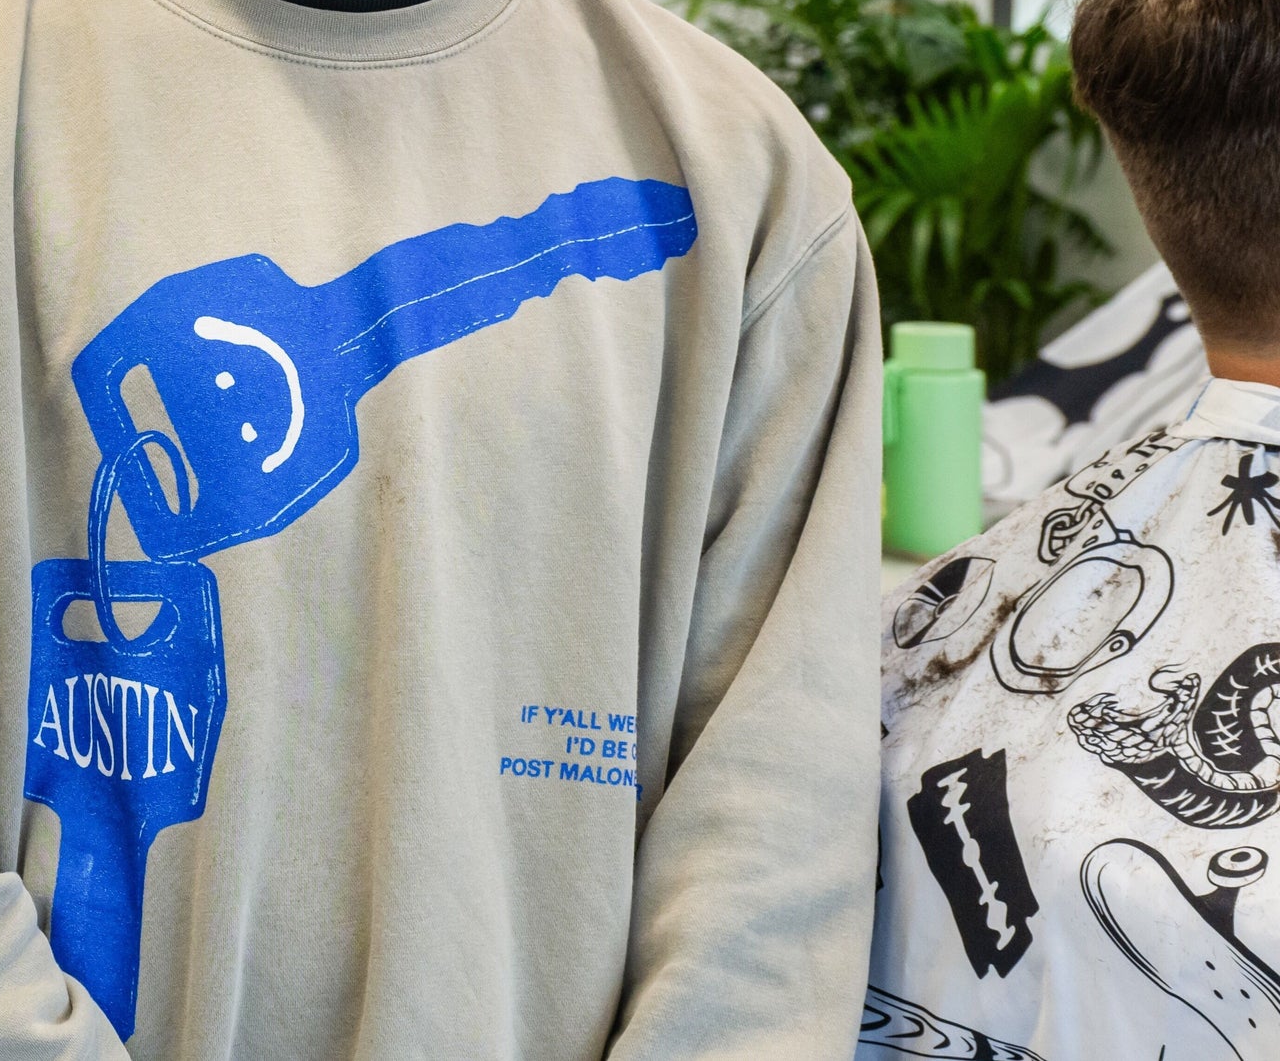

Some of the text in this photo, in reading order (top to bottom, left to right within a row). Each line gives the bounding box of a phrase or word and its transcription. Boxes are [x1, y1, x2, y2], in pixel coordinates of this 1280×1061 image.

[33, 672, 199, 781] AUSTIN
[521, 705, 637, 734] IF Y'ALL WE
[566, 736, 596, 756] I'D
[602, 740, 628, 760] BE
[500, 757, 555, 778] POST
